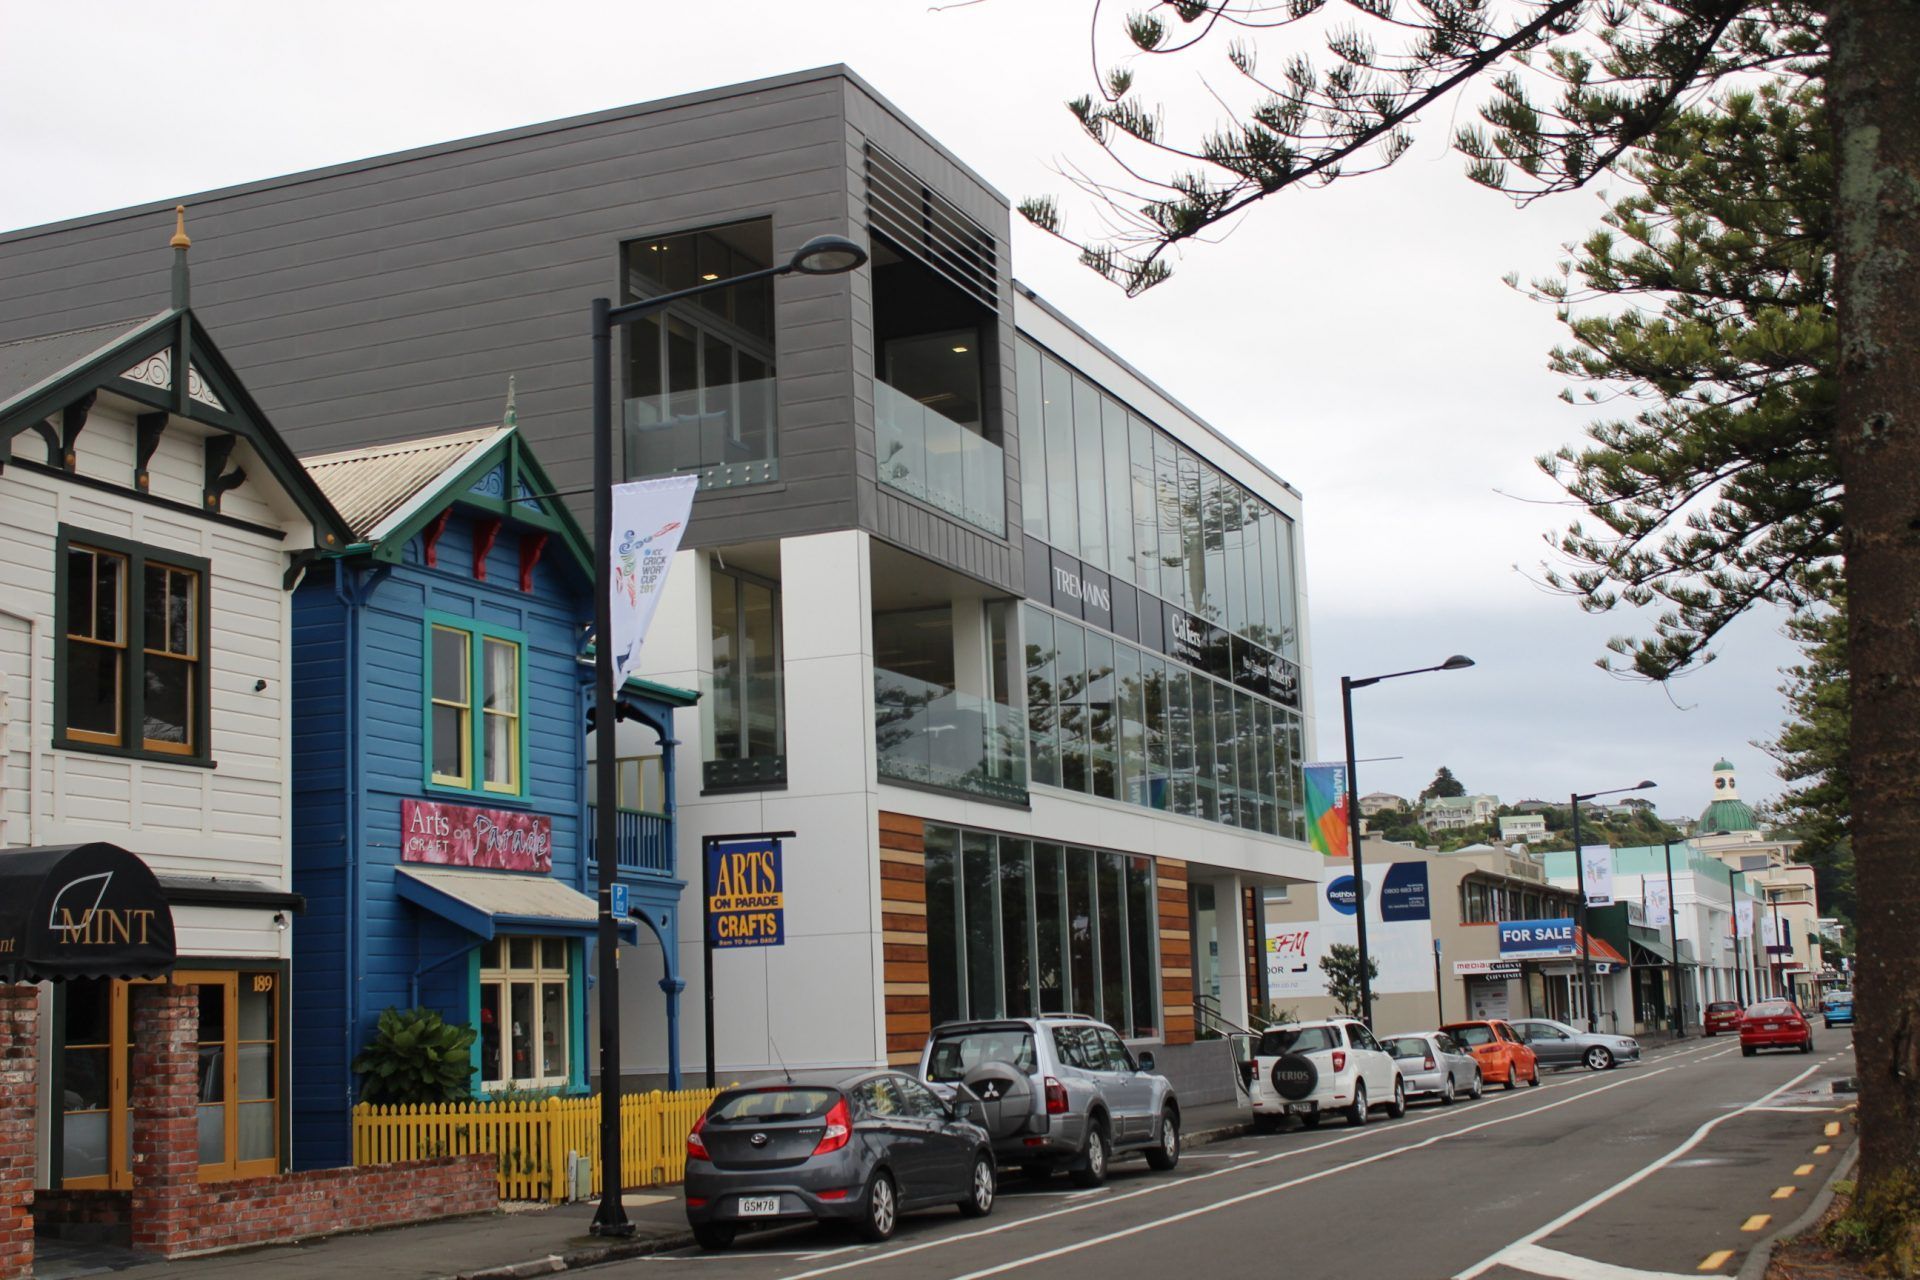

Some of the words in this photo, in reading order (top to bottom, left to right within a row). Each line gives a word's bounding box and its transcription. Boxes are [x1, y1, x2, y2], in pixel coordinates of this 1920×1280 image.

[408, 837, 449, 852] CRAFT
[410, 806, 449, 836] Arts
[473, 814, 547, 868] Parade
[716, 851, 775, 895] ARTS
[617, 887, 623, 899] P
[1330, 890, 1357, 898] Rothbu
[714, 899, 731, 909] ON
[735, 896, 778, 907] PARADE
[60, 907, 155, 944] MINT
[718, 913, 777, 937] CRAFTS
[1503, 930, 1531, 942] FOR
[1535, 927, 1571, 940] SALE
[253, 975, 273, 992] 189
[1277, 1071, 1309, 1080] TERIOS
[744, 1201, 775, 1212] GSM78
